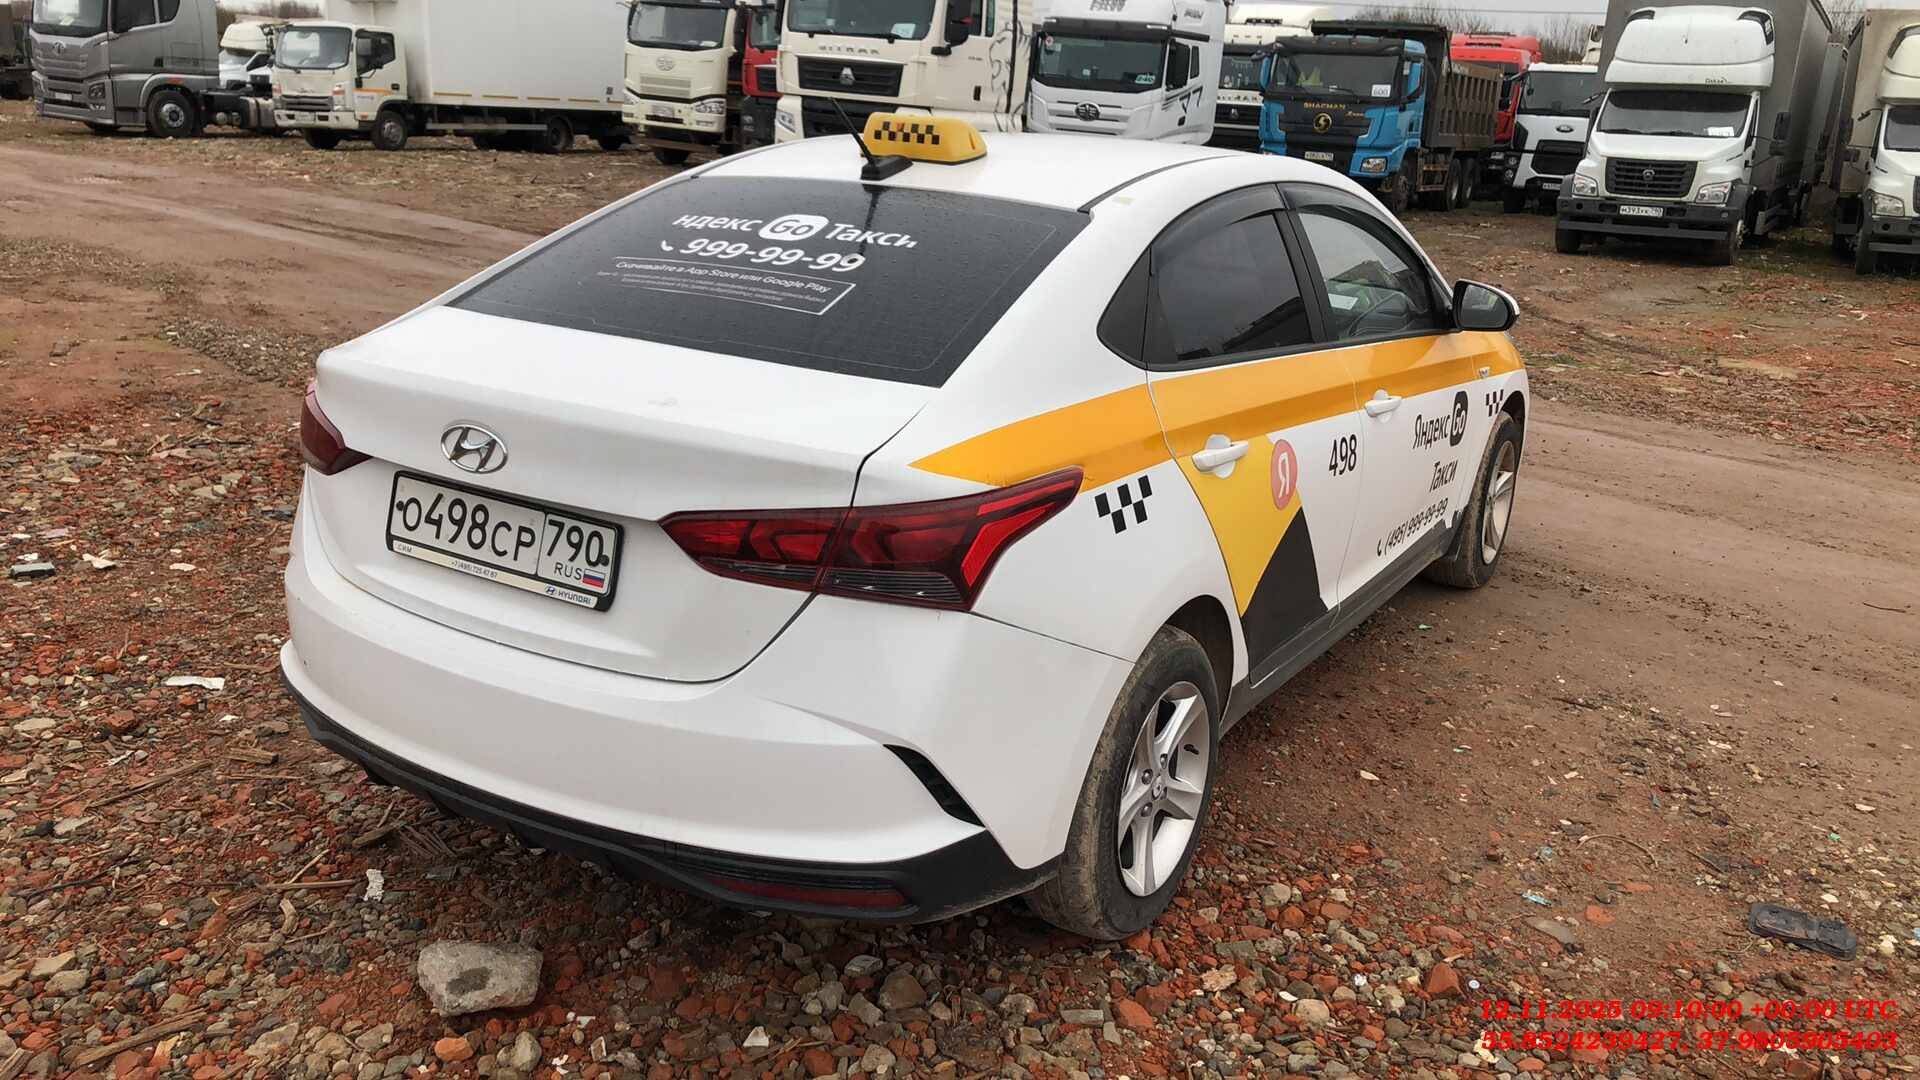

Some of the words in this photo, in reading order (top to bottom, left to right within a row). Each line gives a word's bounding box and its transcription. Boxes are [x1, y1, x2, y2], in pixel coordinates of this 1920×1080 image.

[680, 238, 866, 272] 999-99-99
[804, 282, 832, 293] Play
[1413, 414, 1450, 450] Яндекс
[1328, 434, 1357, 477] 498
[1429, 460, 1458, 493] Такси
[1385, 521, 1408, 555] (495)
[1407, 497, 1448, 537] 999-99-99
[553, 561, 583, 581] RUS
[558, 590, 592, 604] HYUNDAI
